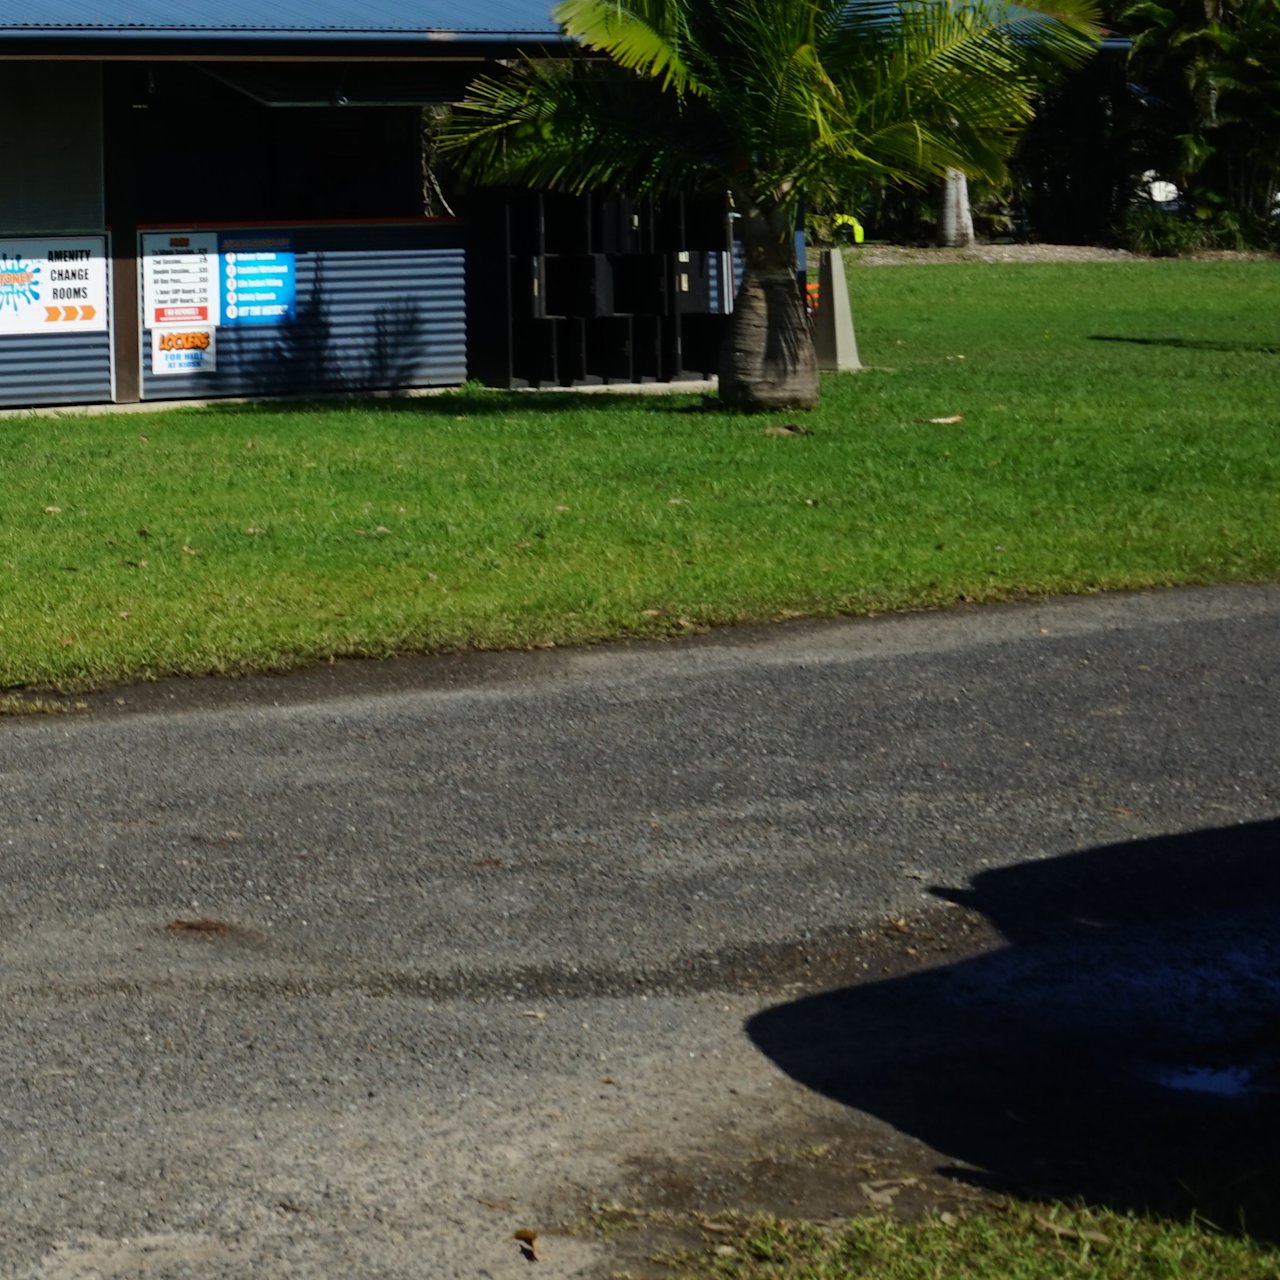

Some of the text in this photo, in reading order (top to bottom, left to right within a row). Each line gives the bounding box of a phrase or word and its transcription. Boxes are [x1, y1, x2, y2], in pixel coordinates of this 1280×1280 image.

[48, 250, 90, 262] AMENITY
[51, 269, 89, 281] CHANGE
[53, 287, 88, 300] ROOMS
[159, 332, 209, 350] LOCKERS
